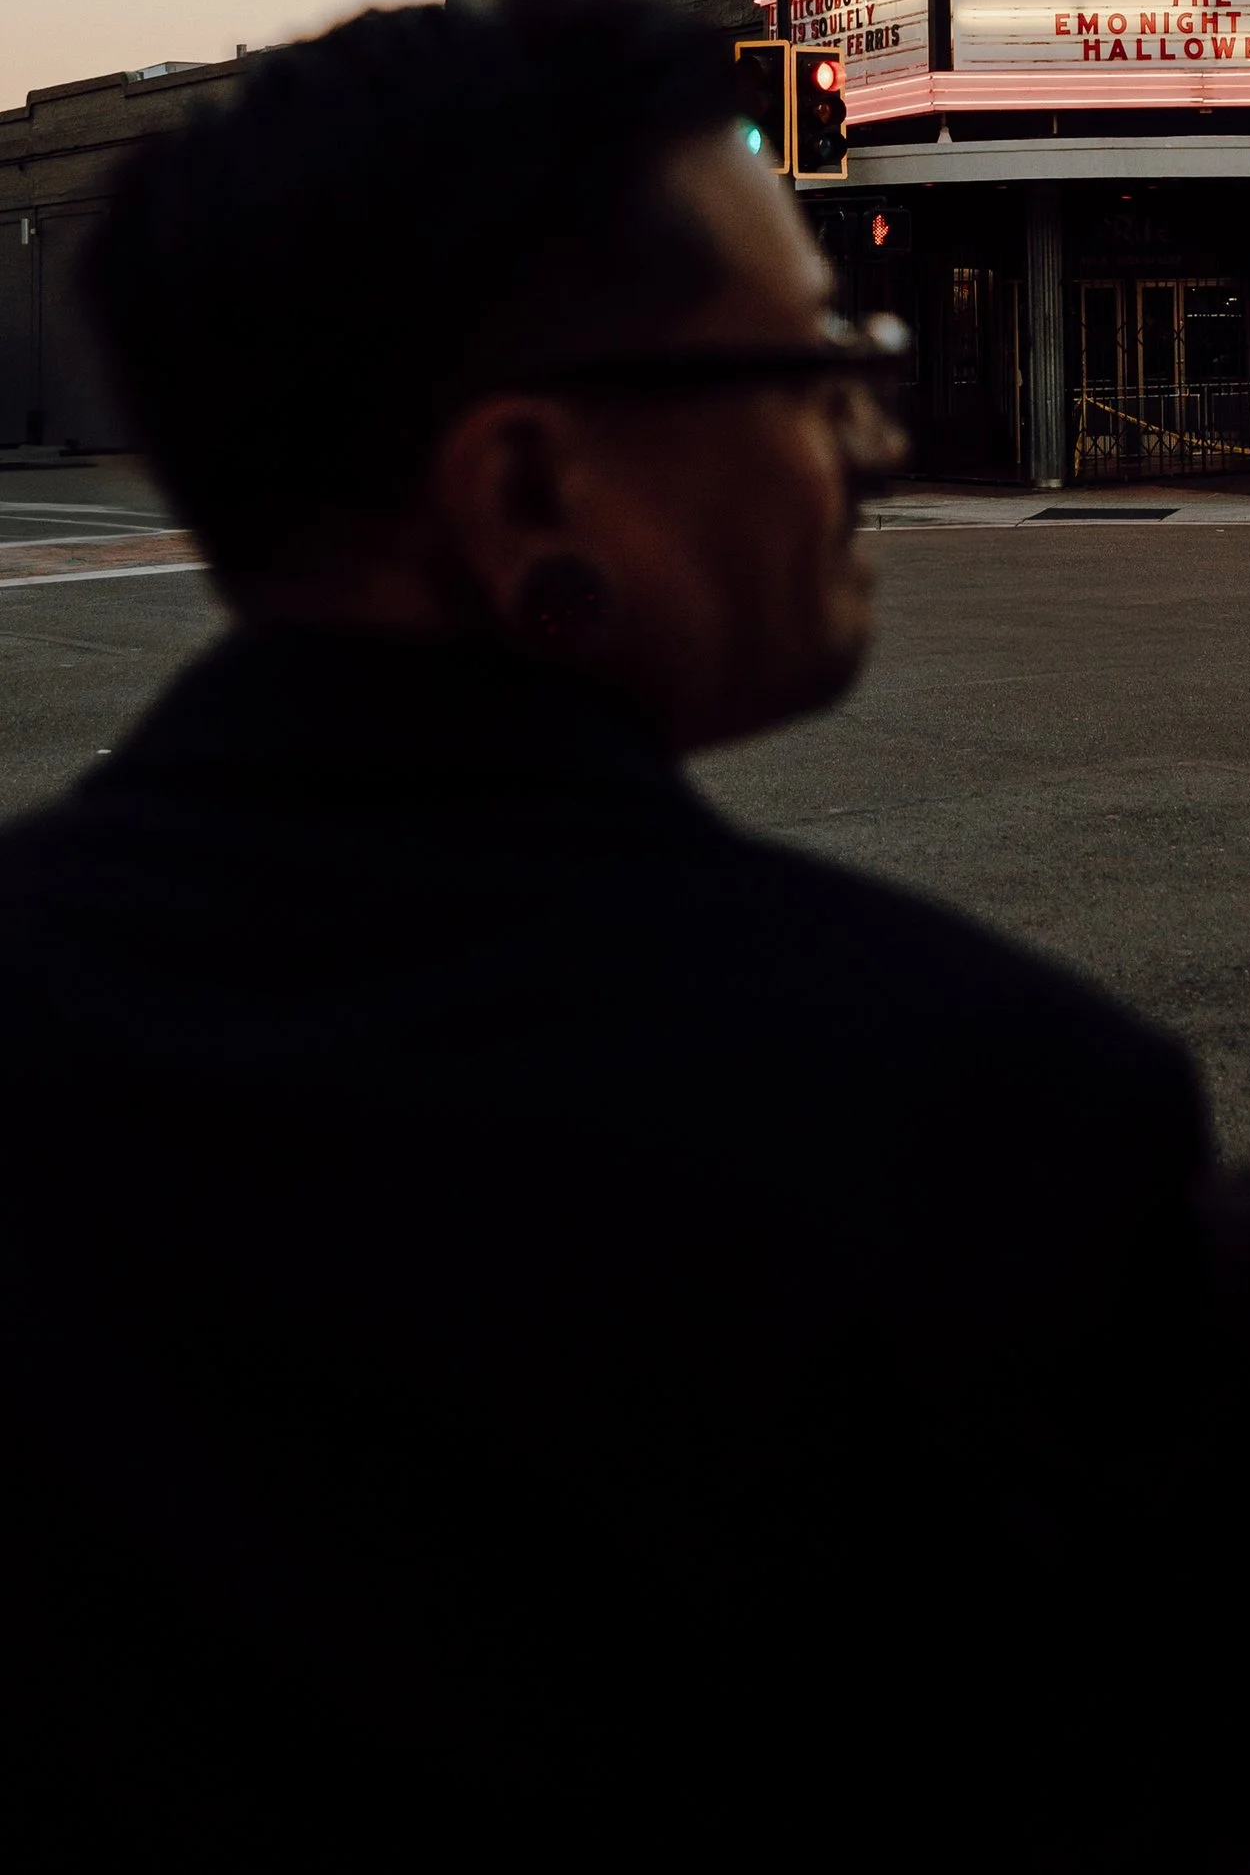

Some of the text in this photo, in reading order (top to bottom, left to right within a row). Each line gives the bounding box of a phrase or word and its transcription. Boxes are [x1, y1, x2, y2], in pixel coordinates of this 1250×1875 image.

[810, 3, 875, 40] SOULFLY
[1055, 12, 1127, 35] EMO
[1140, 11, 1241, 34] NIGHT
[846, 23, 901, 57] FERRIS
